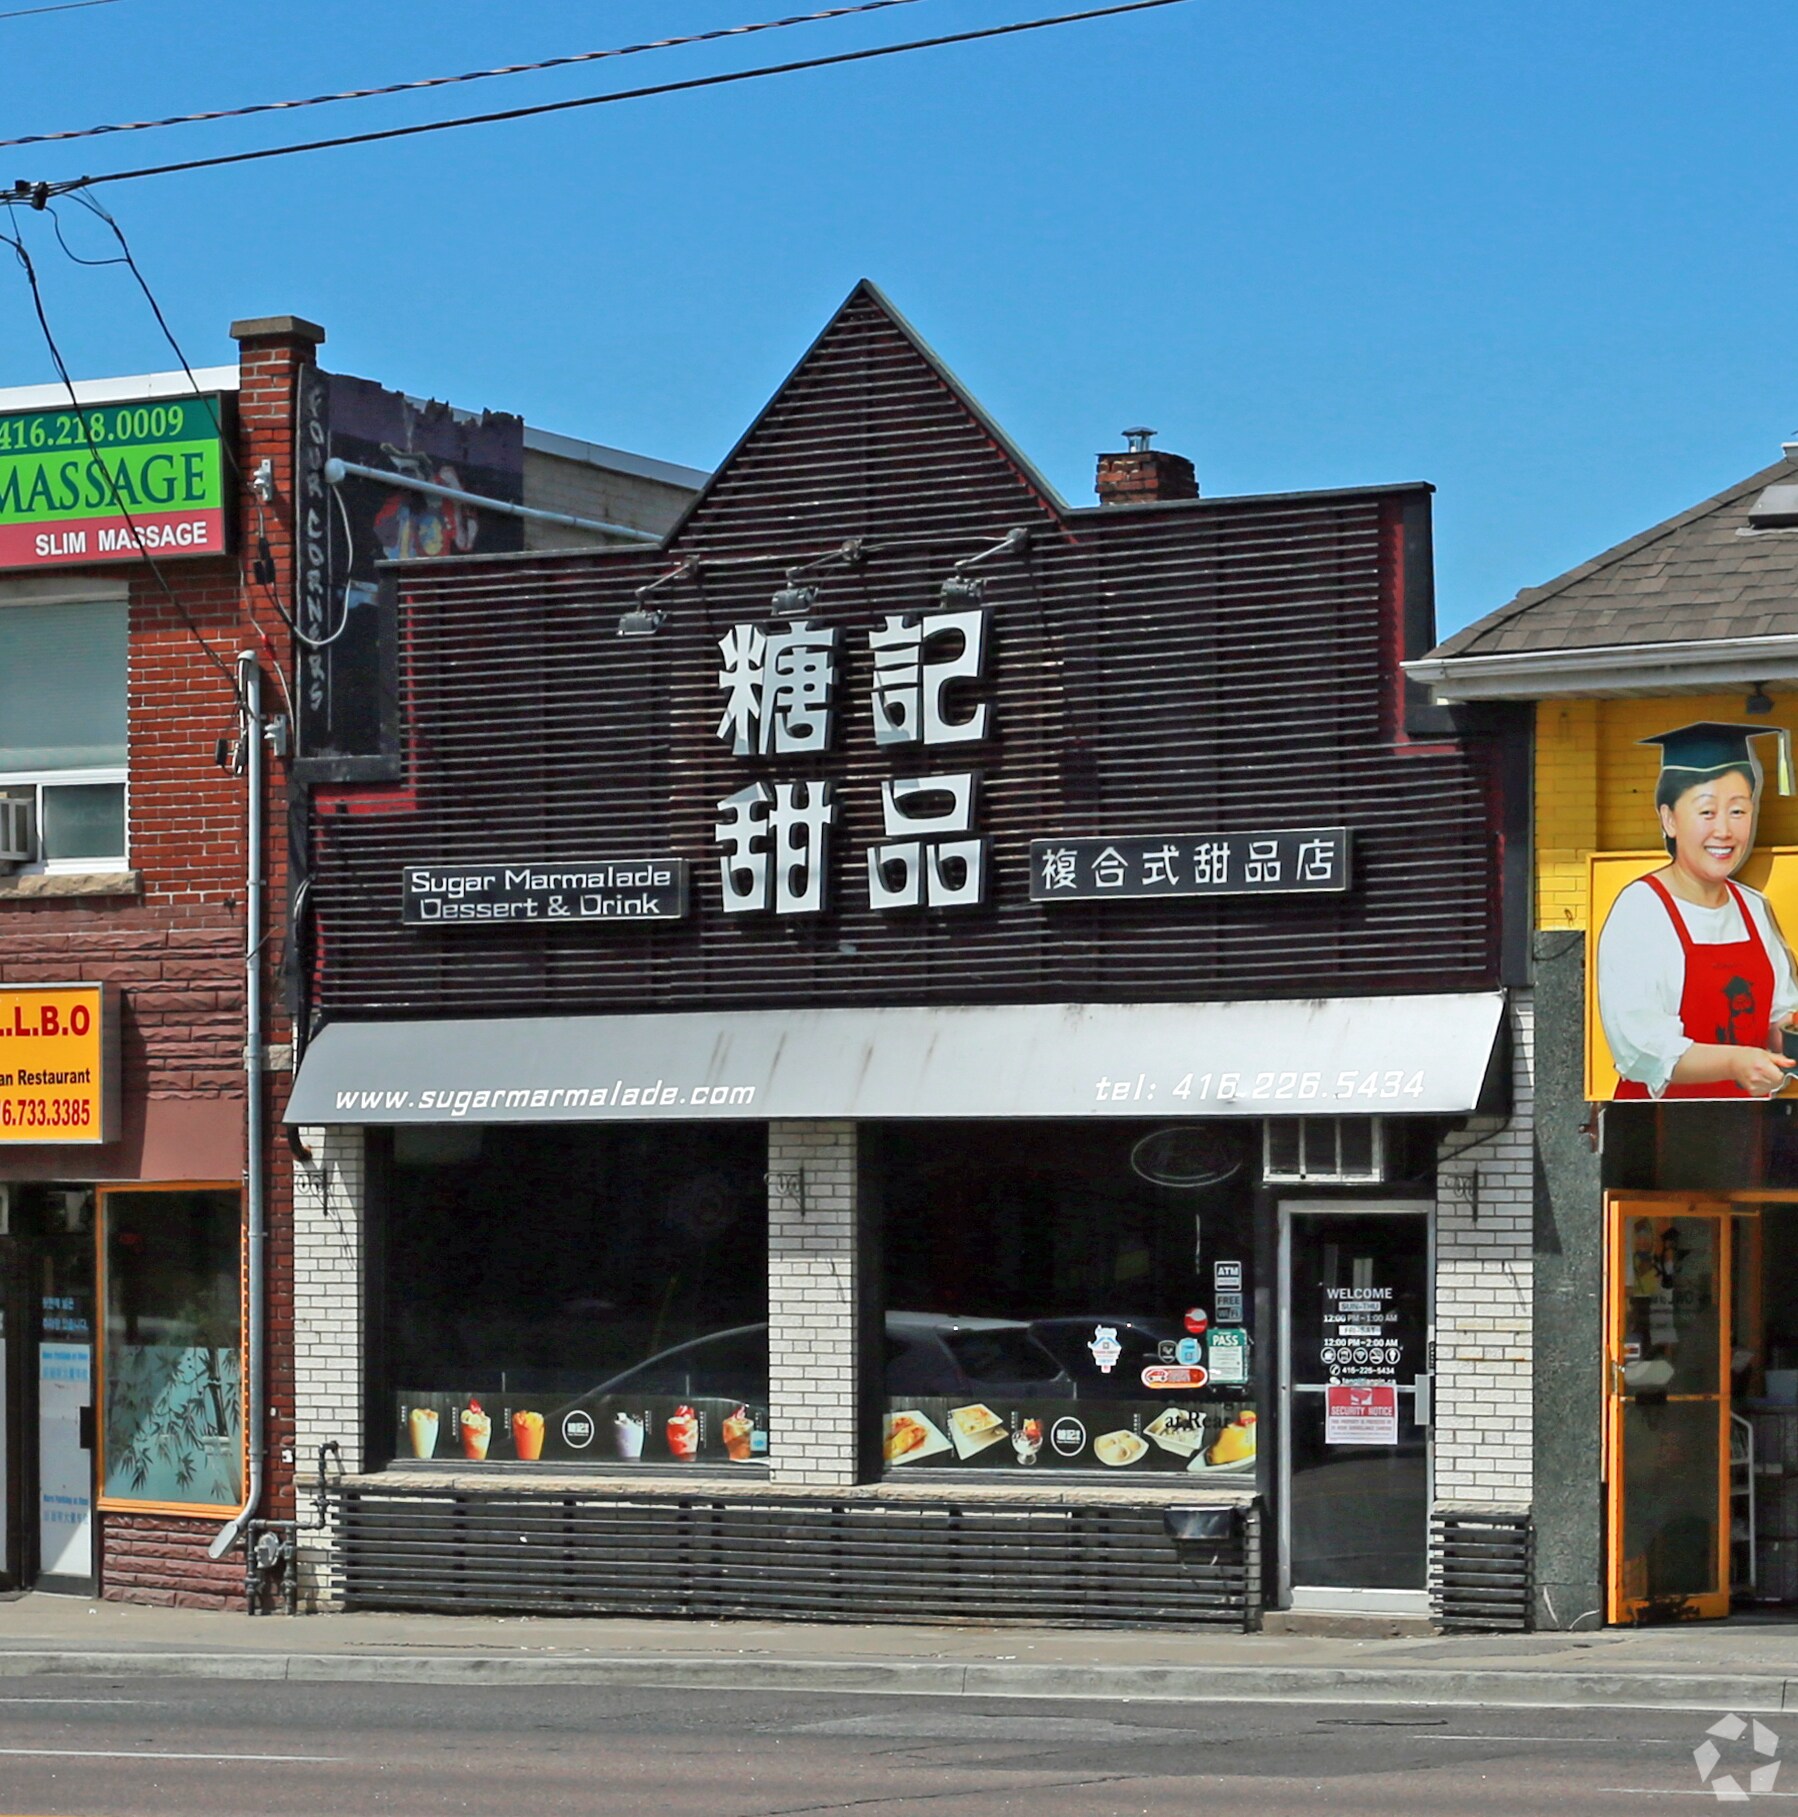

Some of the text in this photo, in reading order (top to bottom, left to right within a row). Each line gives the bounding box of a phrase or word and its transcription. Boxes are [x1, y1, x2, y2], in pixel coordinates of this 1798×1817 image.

[0, 405, 184, 450] 416.218.0009
[35, 521, 208, 556] SLIM MASSAGE
[716, 610, 986, 755] 糖記
[715, 773, 981, 914] 甜品
[1041, 838, 1335, 889] 複合式甜品店
[411, 865, 671, 898] Sugar Marmalade
[420, 893, 660, 919] Dessert & Drink
[18, 1068, 91, 1086] Restaurant
[1095, 1070, 1425, 1102] tel: 416.226.5434
[336, 1080, 756, 1116] www.sugarmarmalade.com
[1218, 1267, 1239, 1276] ATM
[1218, 1296, 1240, 1305] FREE
[1327, 1288, 1393, 1299] WELCOME
[1323, 1314, 1346, 1322] 12:00
[1385, 1314, 1398, 1322] AM
[1212, 1335, 1239, 1346] PASS
[1323, 1339, 1346, 1347] 12:00
[1385, 1339, 1398, 1347] AM
[1331, 1406, 1393, 1416] SECURITY NOTICE
